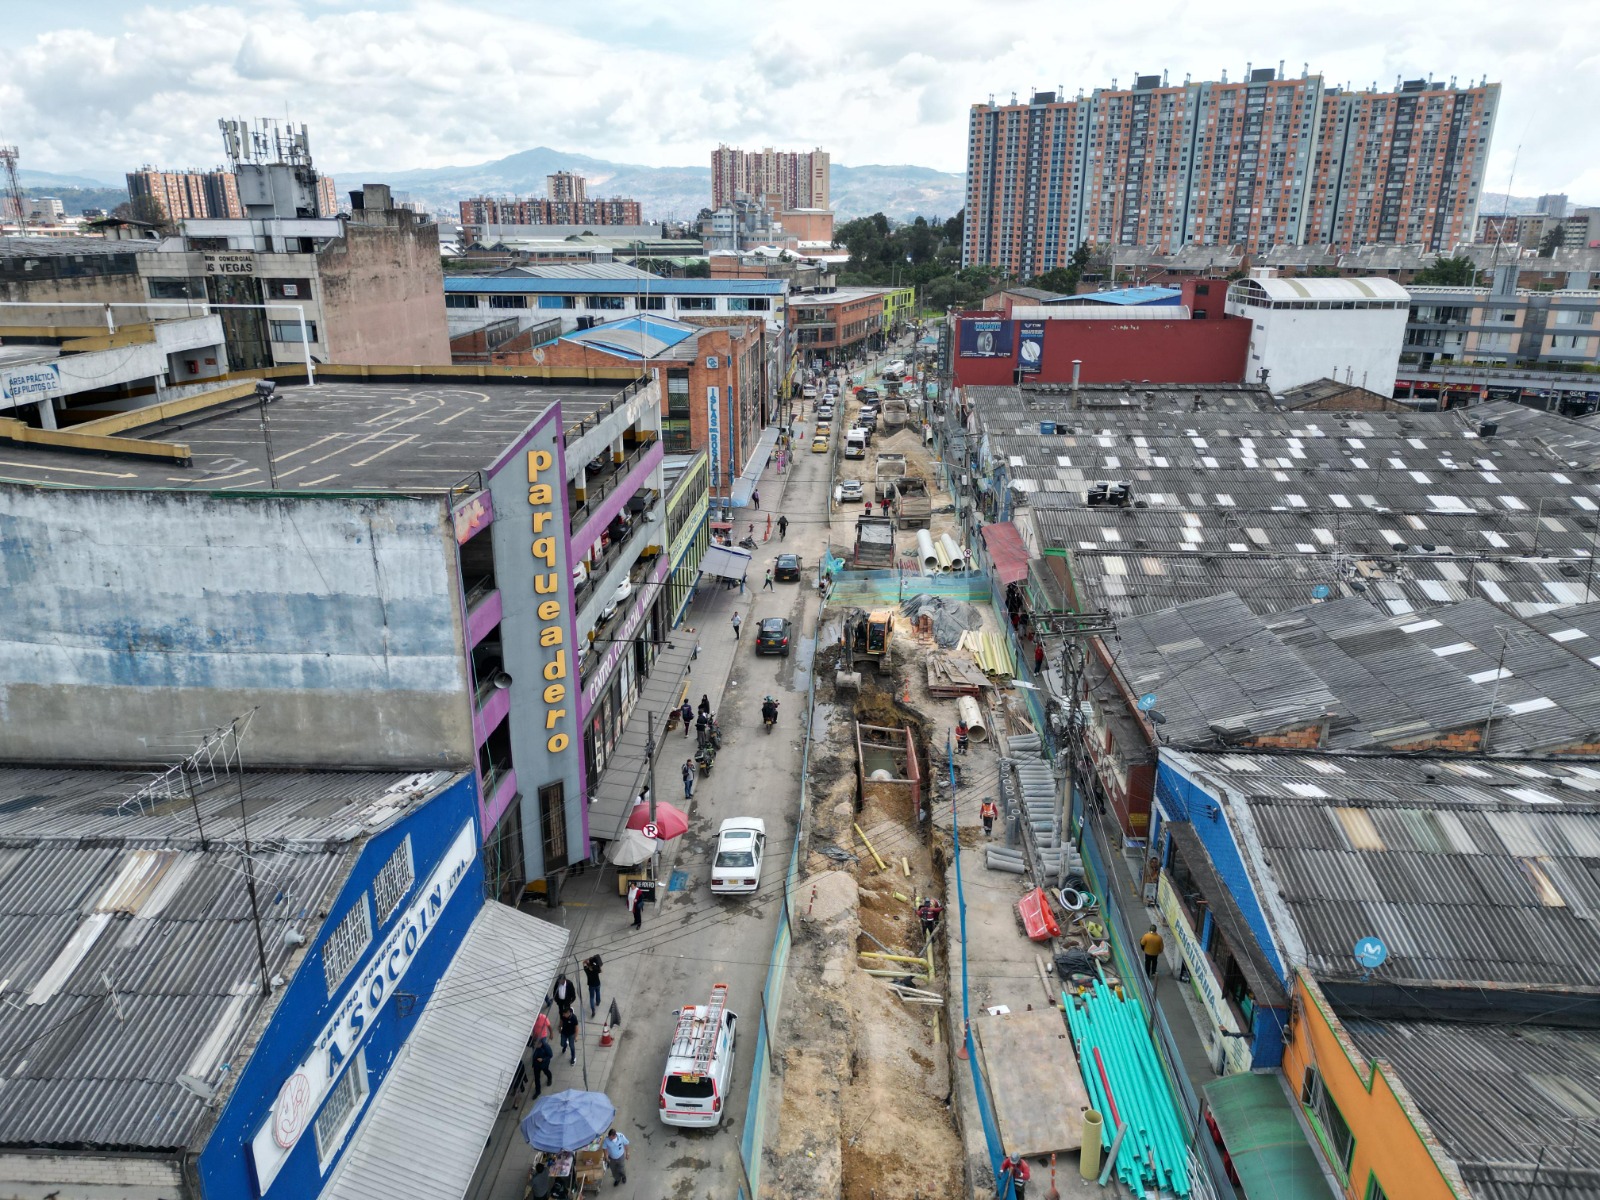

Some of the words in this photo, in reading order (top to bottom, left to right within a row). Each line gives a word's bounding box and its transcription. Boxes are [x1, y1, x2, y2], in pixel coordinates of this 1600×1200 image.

[220, 264, 252, 272] VEGAS
[22, 382, 46, 394] PILOTOS
[26, 372, 54, 383] PRÁCTICA
[527, 450, 570, 753] parqueadero
[590, 657, 614, 706] CENTRO
[320, 990, 359, 1051] CENTRO
[363, 916, 411, 987] COMERCIAL
[328, 883, 442, 1079] ASOCOIN
[1175, 918, 1215, 1010] PENSILVANIA
